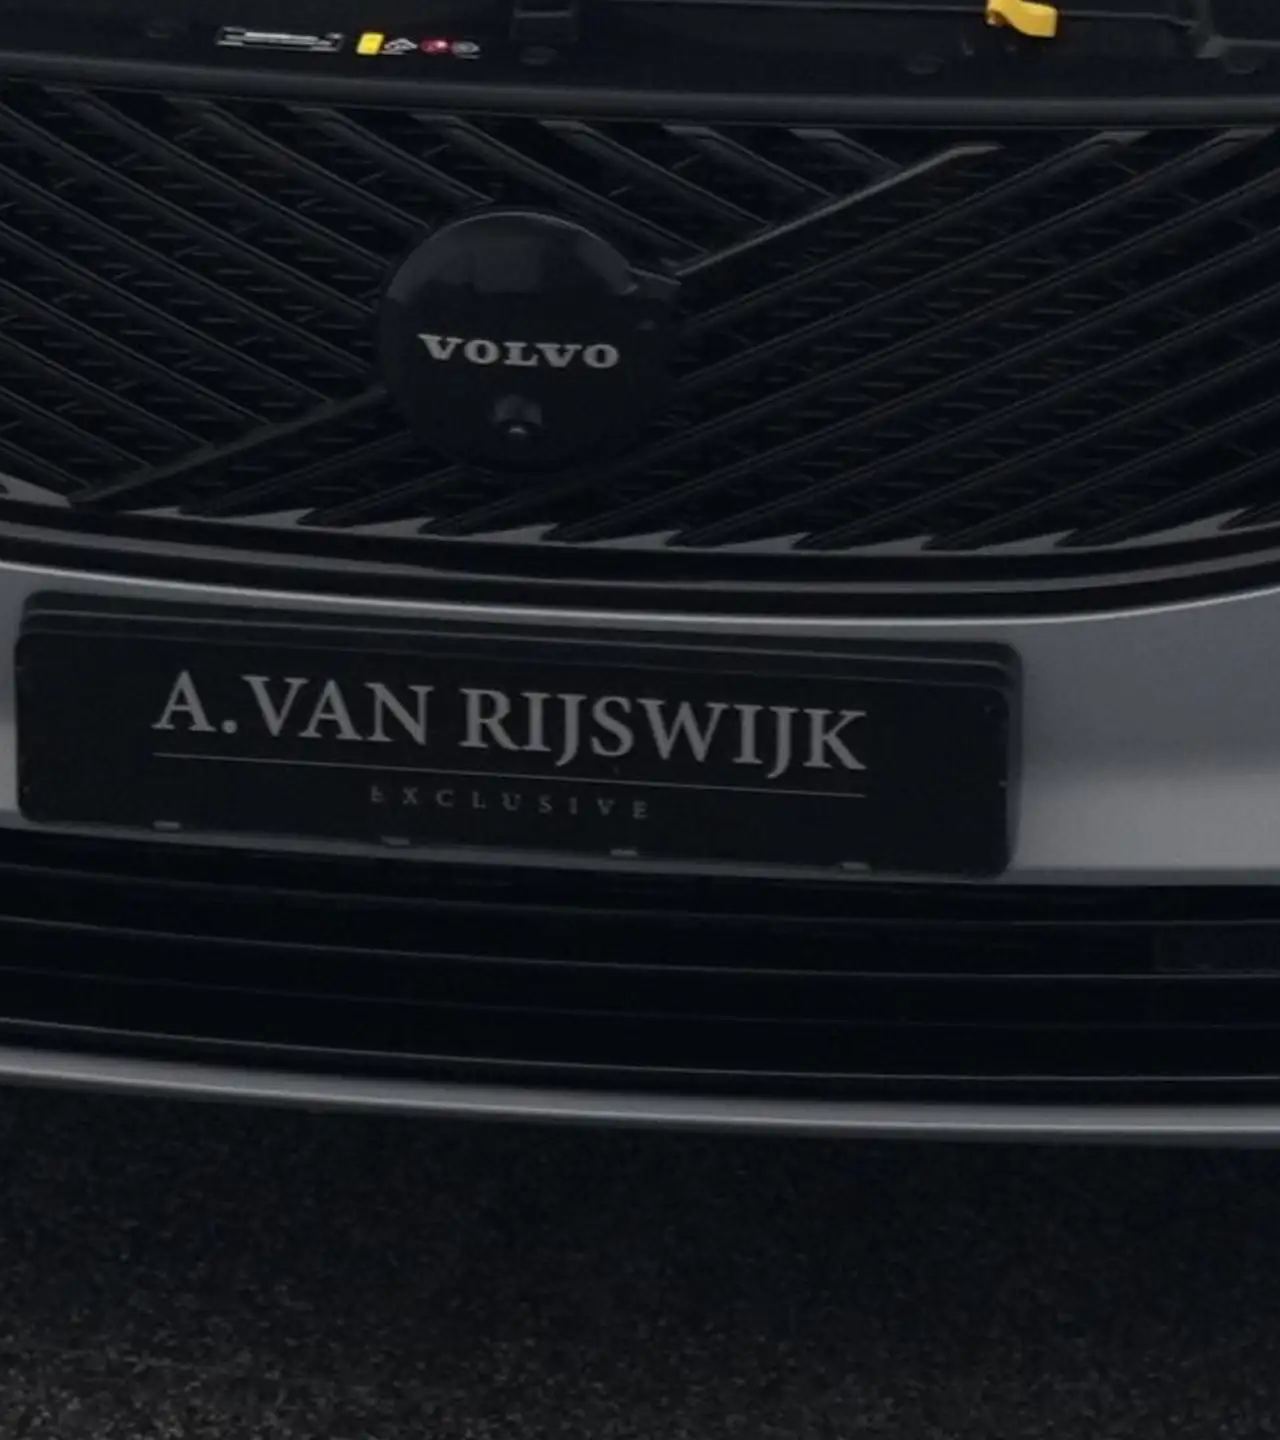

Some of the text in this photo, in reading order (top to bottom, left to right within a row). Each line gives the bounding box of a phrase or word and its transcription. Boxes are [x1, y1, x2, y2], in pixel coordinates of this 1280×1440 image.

[417, 333, 620, 369] VOLVO
[458, 687, 867, 779] RIJSWIJK
[370, 784, 649, 820] EXCLUSIVE
